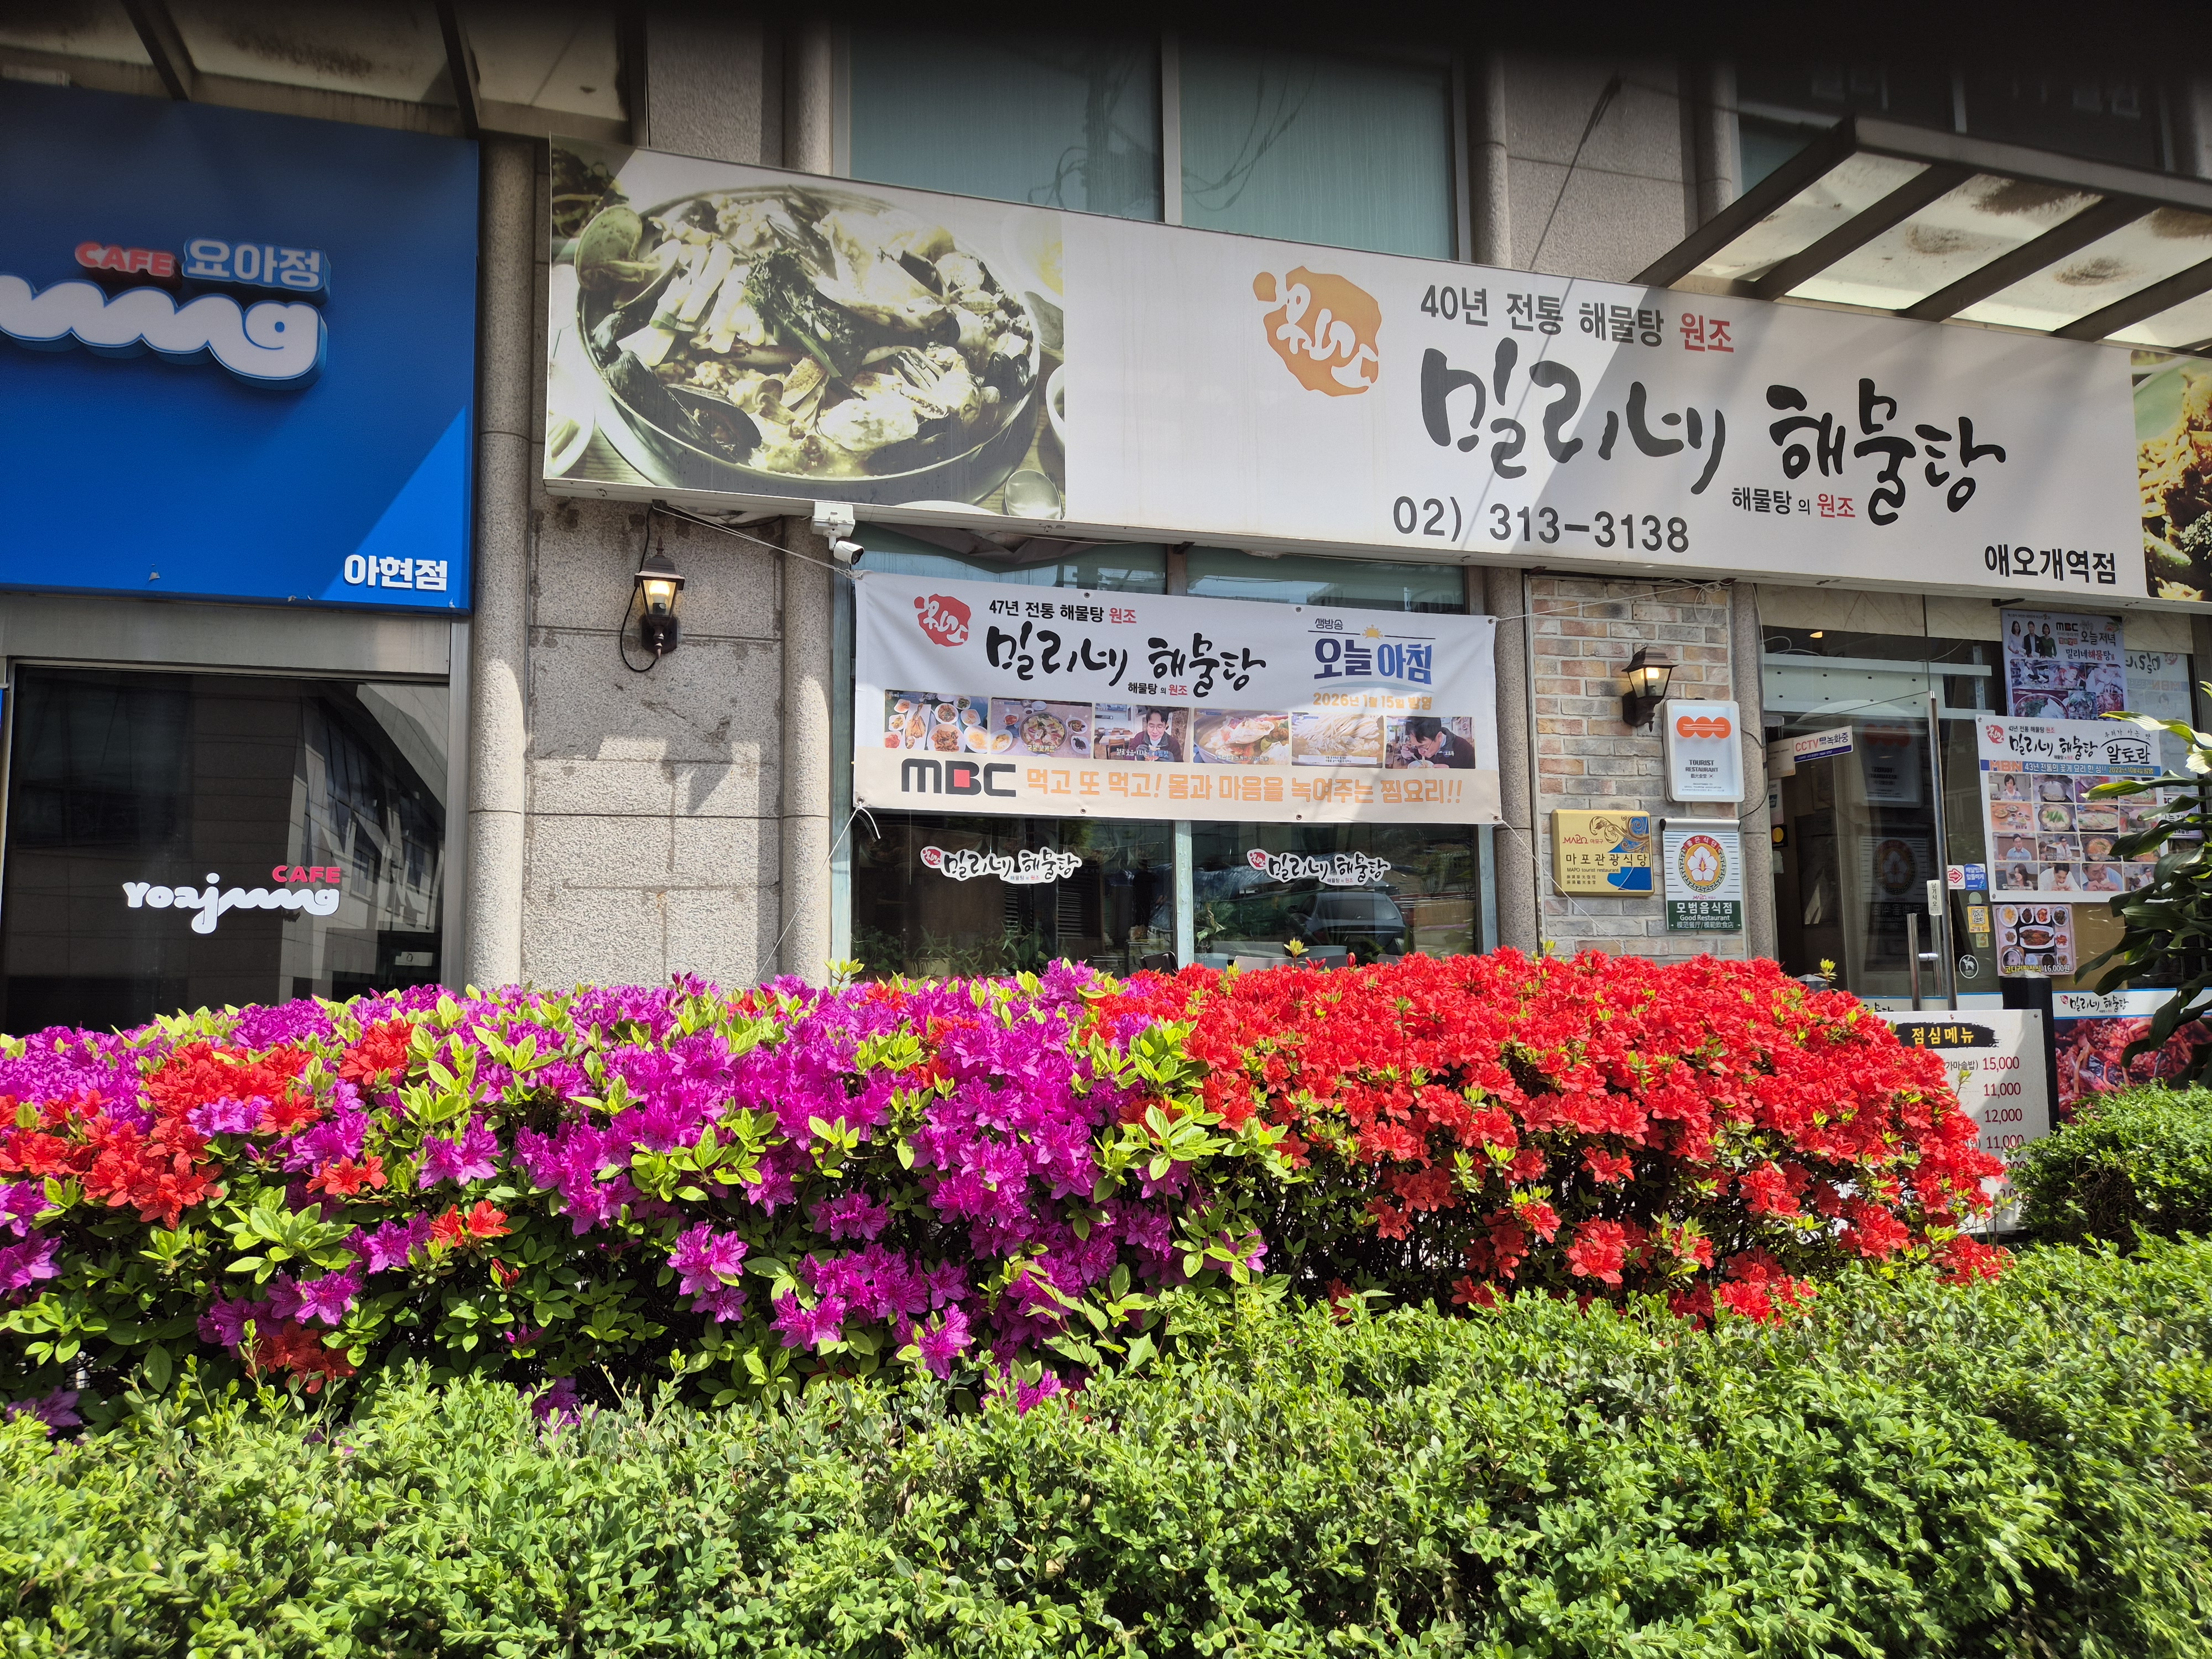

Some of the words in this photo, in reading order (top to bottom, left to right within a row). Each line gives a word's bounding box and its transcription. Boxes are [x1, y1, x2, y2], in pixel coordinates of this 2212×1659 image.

[77, 242, 175, 276] CAFE
[187, 239, 321, 286] 요아정
[1420, 284, 1489, 327] 40년
[1505, 293, 1564, 336] 전통
[1578, 301, 1665, 347] 해물탕
[1679, 312, 1734, 353] 원조
[1421, 337, 1726, 495] 밀리네
[1766, 378, 2006, 526] 해물탕
[1731, 486, 1791, 515] 해물탕
[1797, 498, 1811, 516] 의
[1817, 493, 1856, 519] 원조
[1392, 495, 1463, 542] 02)
[1489, 503, 1690, 553] 313-3138
[343, 554, 448, 591] 아현점
[1984, 544, 2116, 585] 애오개역점
[989, 600, 1019, 617] 47년
[1025, 602, 1055, 619] 전통
[1060, 604, 1104, 623] 해물탕
[1109, 607, 1137, 624] 원조
[1314, 617, 1344, 630] 생방송
[2056, 622, 2079, 632] MBC
[986, 620, 1128, 686] 밀리네
[1147, 632, 1267, 698] 해물탕
[1128, 682, 1158, 695] 해물탕
[1168, 684, 1188, 696] 원조
[1313, 692, 1359, 707] 2026년
[1362, 694, 1378, 708] 1월
[1381, 695, 1405, 709] 15일
[1407, 696, 1432, 710] 방영
[1795, 738, 1819, 752] CCTV
[1827, 732, 1849, 745] 녹화중
[2104, 728, 2122, 738] 우리가
[2127, 728, 2140, 737] 아는
[2008, 733, 2053, 757] 밀리네
[2058, 735, 2099, 760] 해물탕
[2106, 743, 2151, 765] 알토란
[1990, 759, 2023, 772] MBN
[2025, 763, 2039, 771] 43년
[2041, 763, 2059, 772] 전통의
[2060, 764, 2073, 773] 꽃게
[2074, 764, 2086, 773] 요리
[901, 758, 1016, 797] MBC
[1027, 768, 1071, 795] 먹고
[1079, 770, 1100, 796] 또
[1108, 772, 1161, 799] 먹고!
[1168, 774, 1212, 801] 몸과
[1218, 775, 1284, 802] 마음을
[1291, 777, 1374, 804] 녹여주는
[1380, 779, 1462, 804] 찜요리!!
[1562, 834, 1589, 844] MAPO
[943, 850, 1012, 878] 밀리네
[1021, 849, 1079, 880] 해물탕
[1268, 854, 1329, 880] 밀리네
[1336, 853, 1388, 883] 해물탕
[1566, 853, 1647, 867] 마포관광식당
[272, 865, 341, 884] CAFE
[1676, 901, 1733, 915] 모범음식점
[2043, 964, 2070, 973] 16,000원
[2069, 996, 2100, 1012] 밀리네
[2103, 995, 2130, 1013] 해물탕
[1911, 1026, 1975, 1045] 점심메뉴
[1983, 1056, 2020, 1073] 15,000
[1983, 1082, 2021, 1099] 11,000
[1984, 1108, 2023, 1125] 12,000
